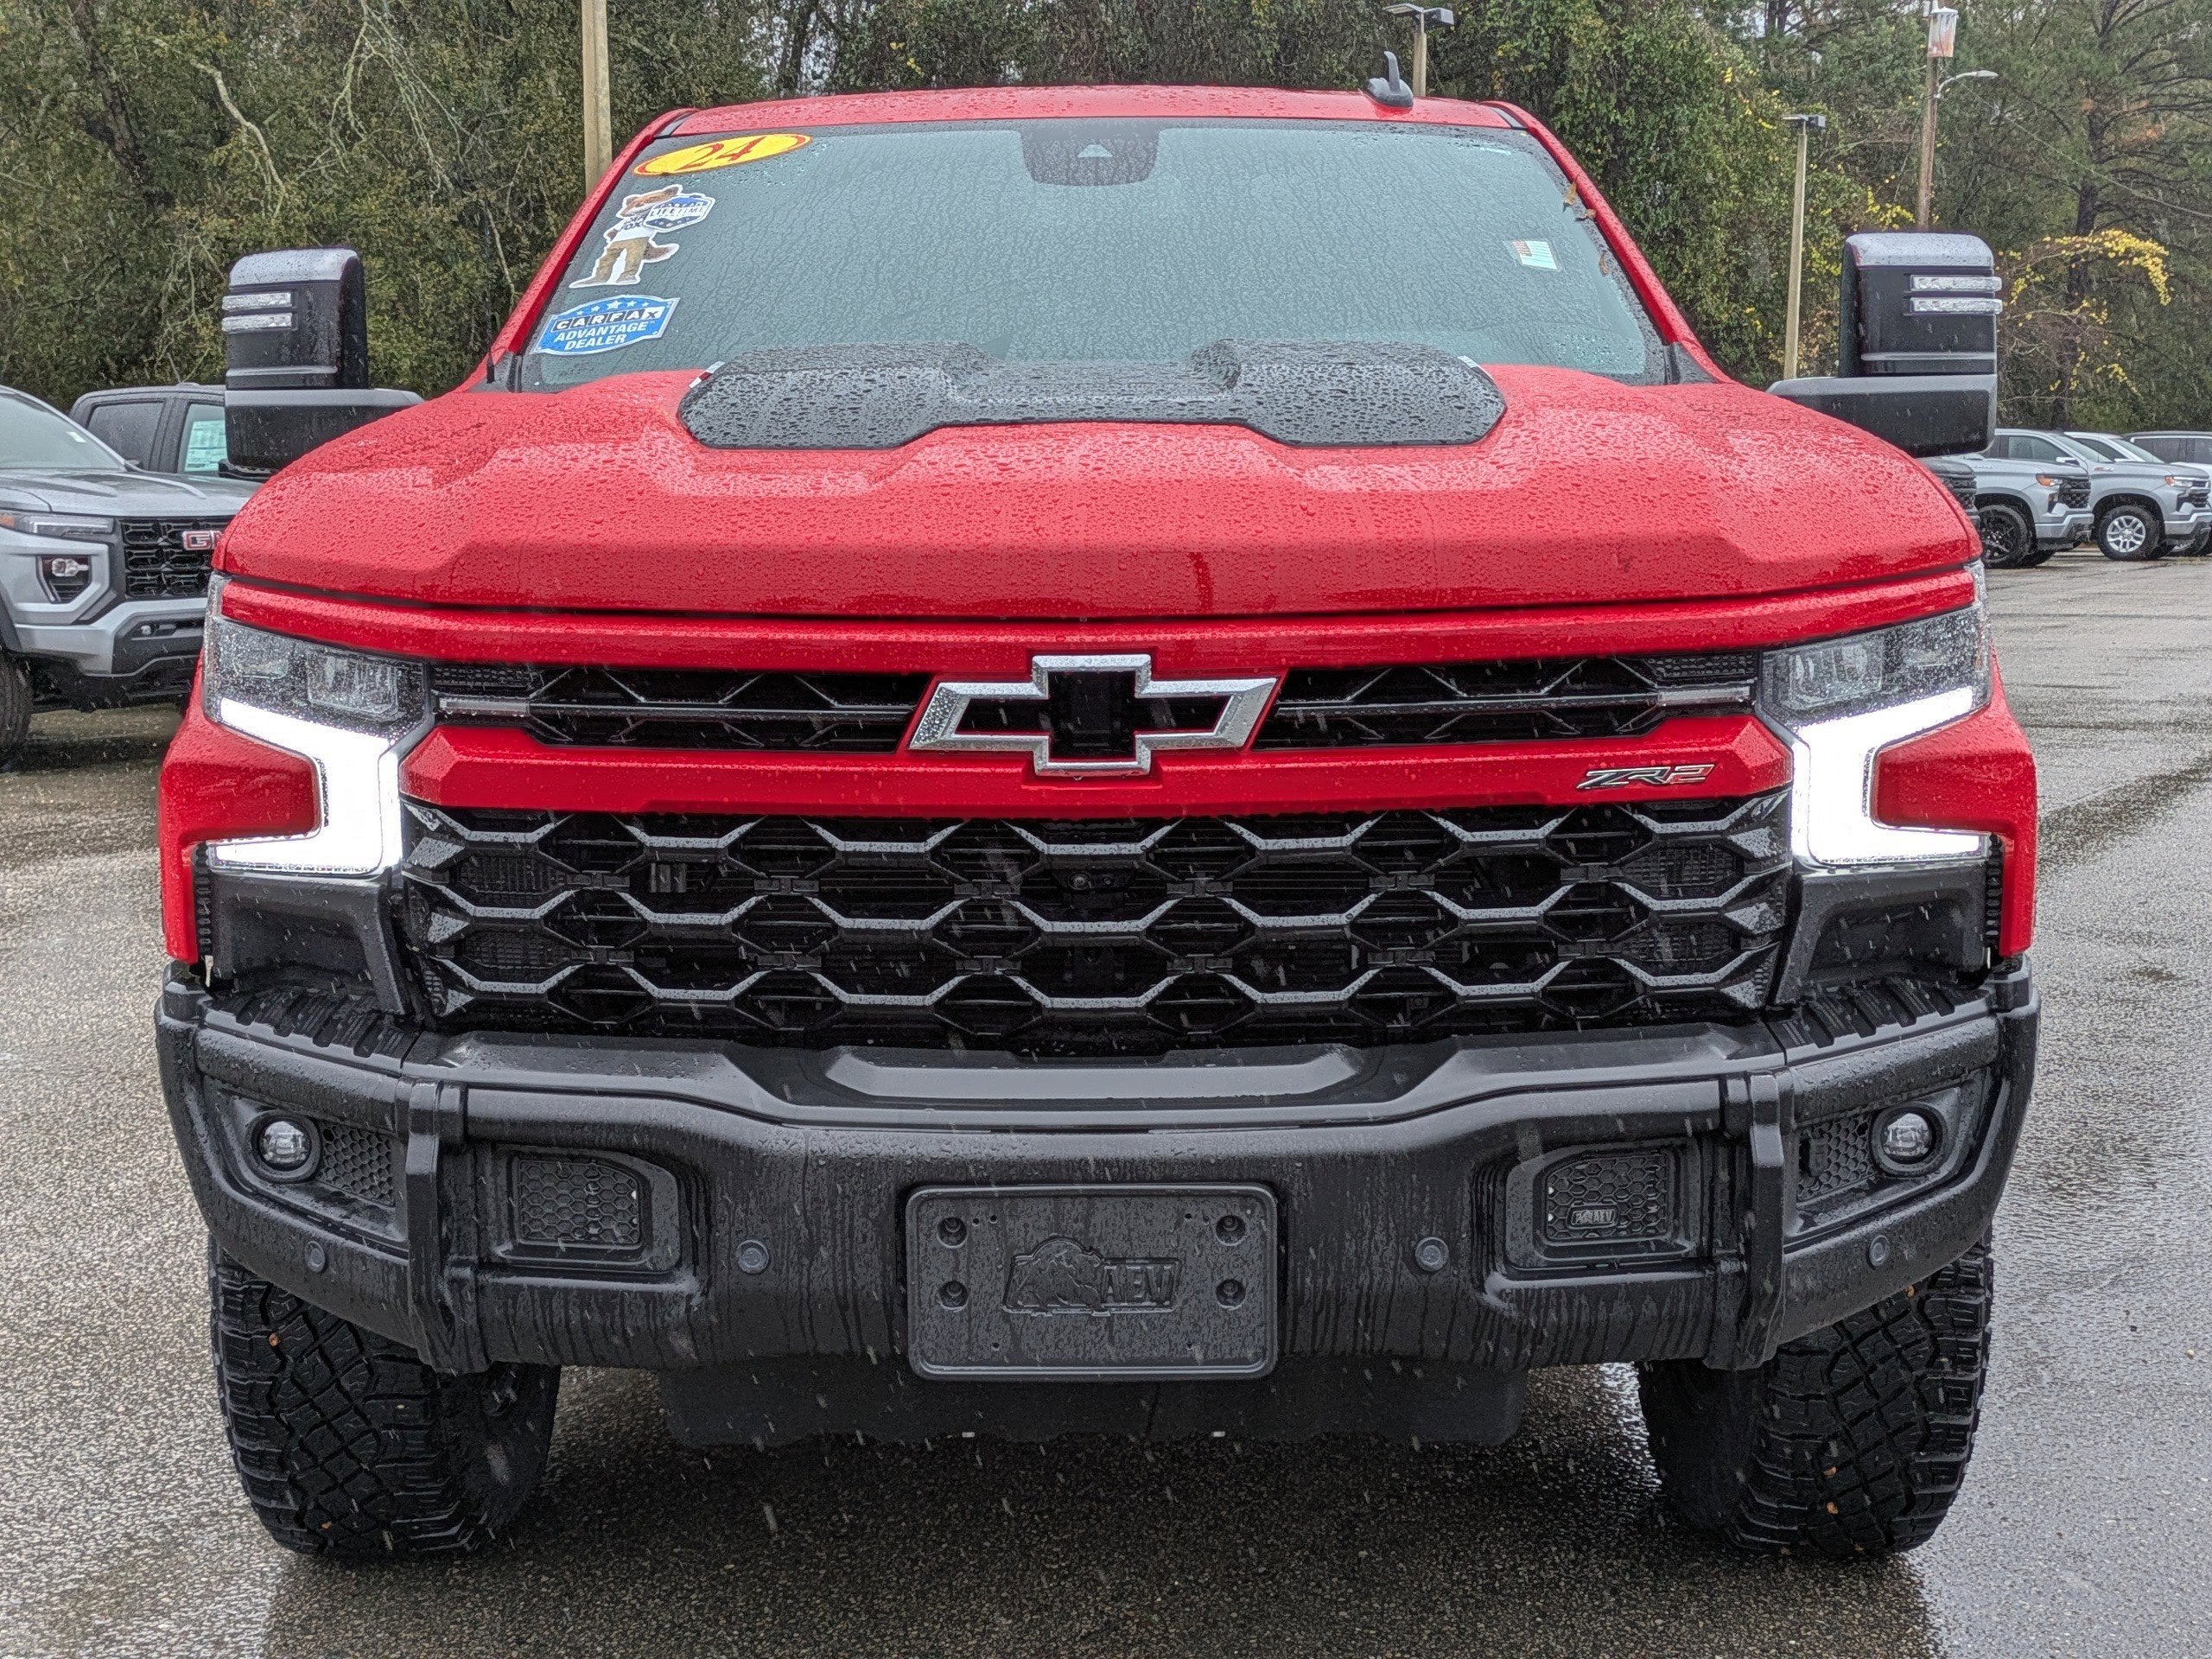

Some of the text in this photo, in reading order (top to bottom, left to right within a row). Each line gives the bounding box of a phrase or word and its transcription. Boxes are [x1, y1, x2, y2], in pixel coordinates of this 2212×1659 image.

[675, 136, 767, 171] 24
[555, 308, 662, 331] CARFAX
[554, 321, 648, 343] ADVANTAGE
[563, 334, 627, 351] DEALER
[1576, 764, 1715, 789] ZR2
[1101, 1264, 1175, 1305] AEV
